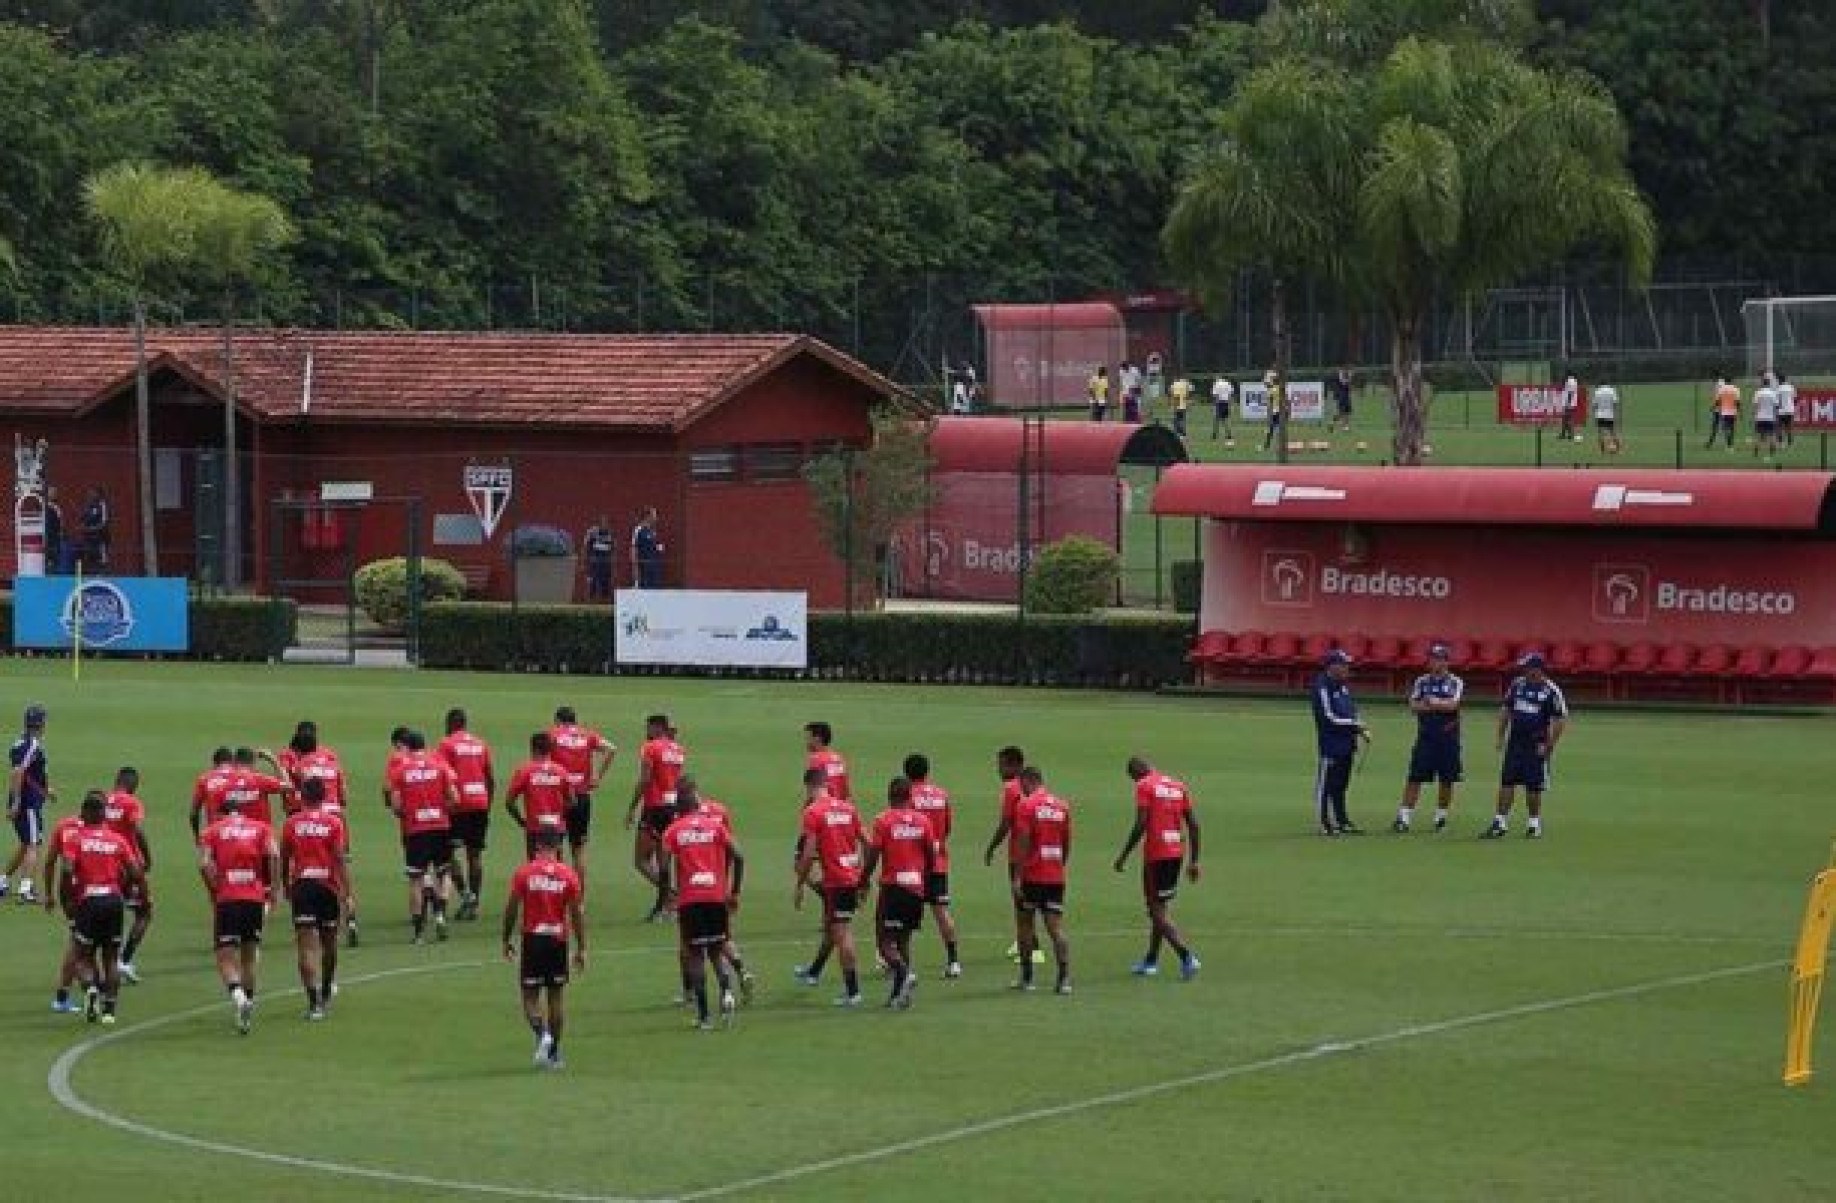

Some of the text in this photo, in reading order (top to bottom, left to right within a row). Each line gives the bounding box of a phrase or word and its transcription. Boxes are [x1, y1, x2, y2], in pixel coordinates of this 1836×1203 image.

[1511, 387, 1566, 415] URBAN
[1321, 567, 1450, 597] Bradesco
[1657, 582, 1795, 615] Bradesco
